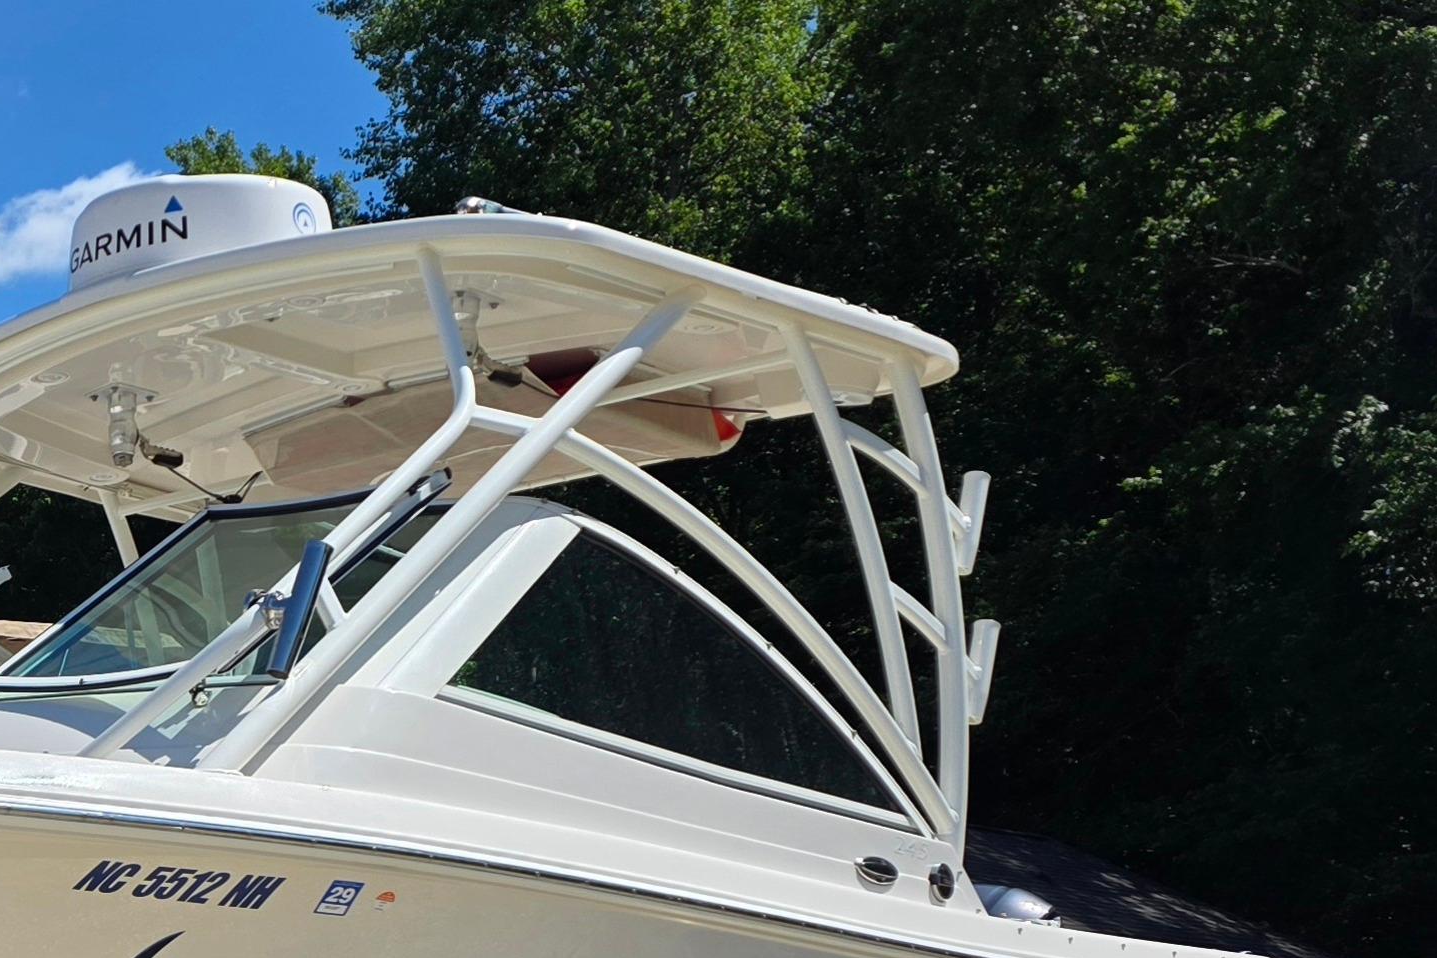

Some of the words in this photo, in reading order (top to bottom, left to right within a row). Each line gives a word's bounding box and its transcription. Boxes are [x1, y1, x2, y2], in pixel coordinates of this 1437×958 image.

[70, 215, 188, 274] GARMIN
[72, 860, 140, 893] NC
[132, 866, 231, 904] 5512
[217, 874, 287, 910] NH
[324, 886, 356, 904] 29
